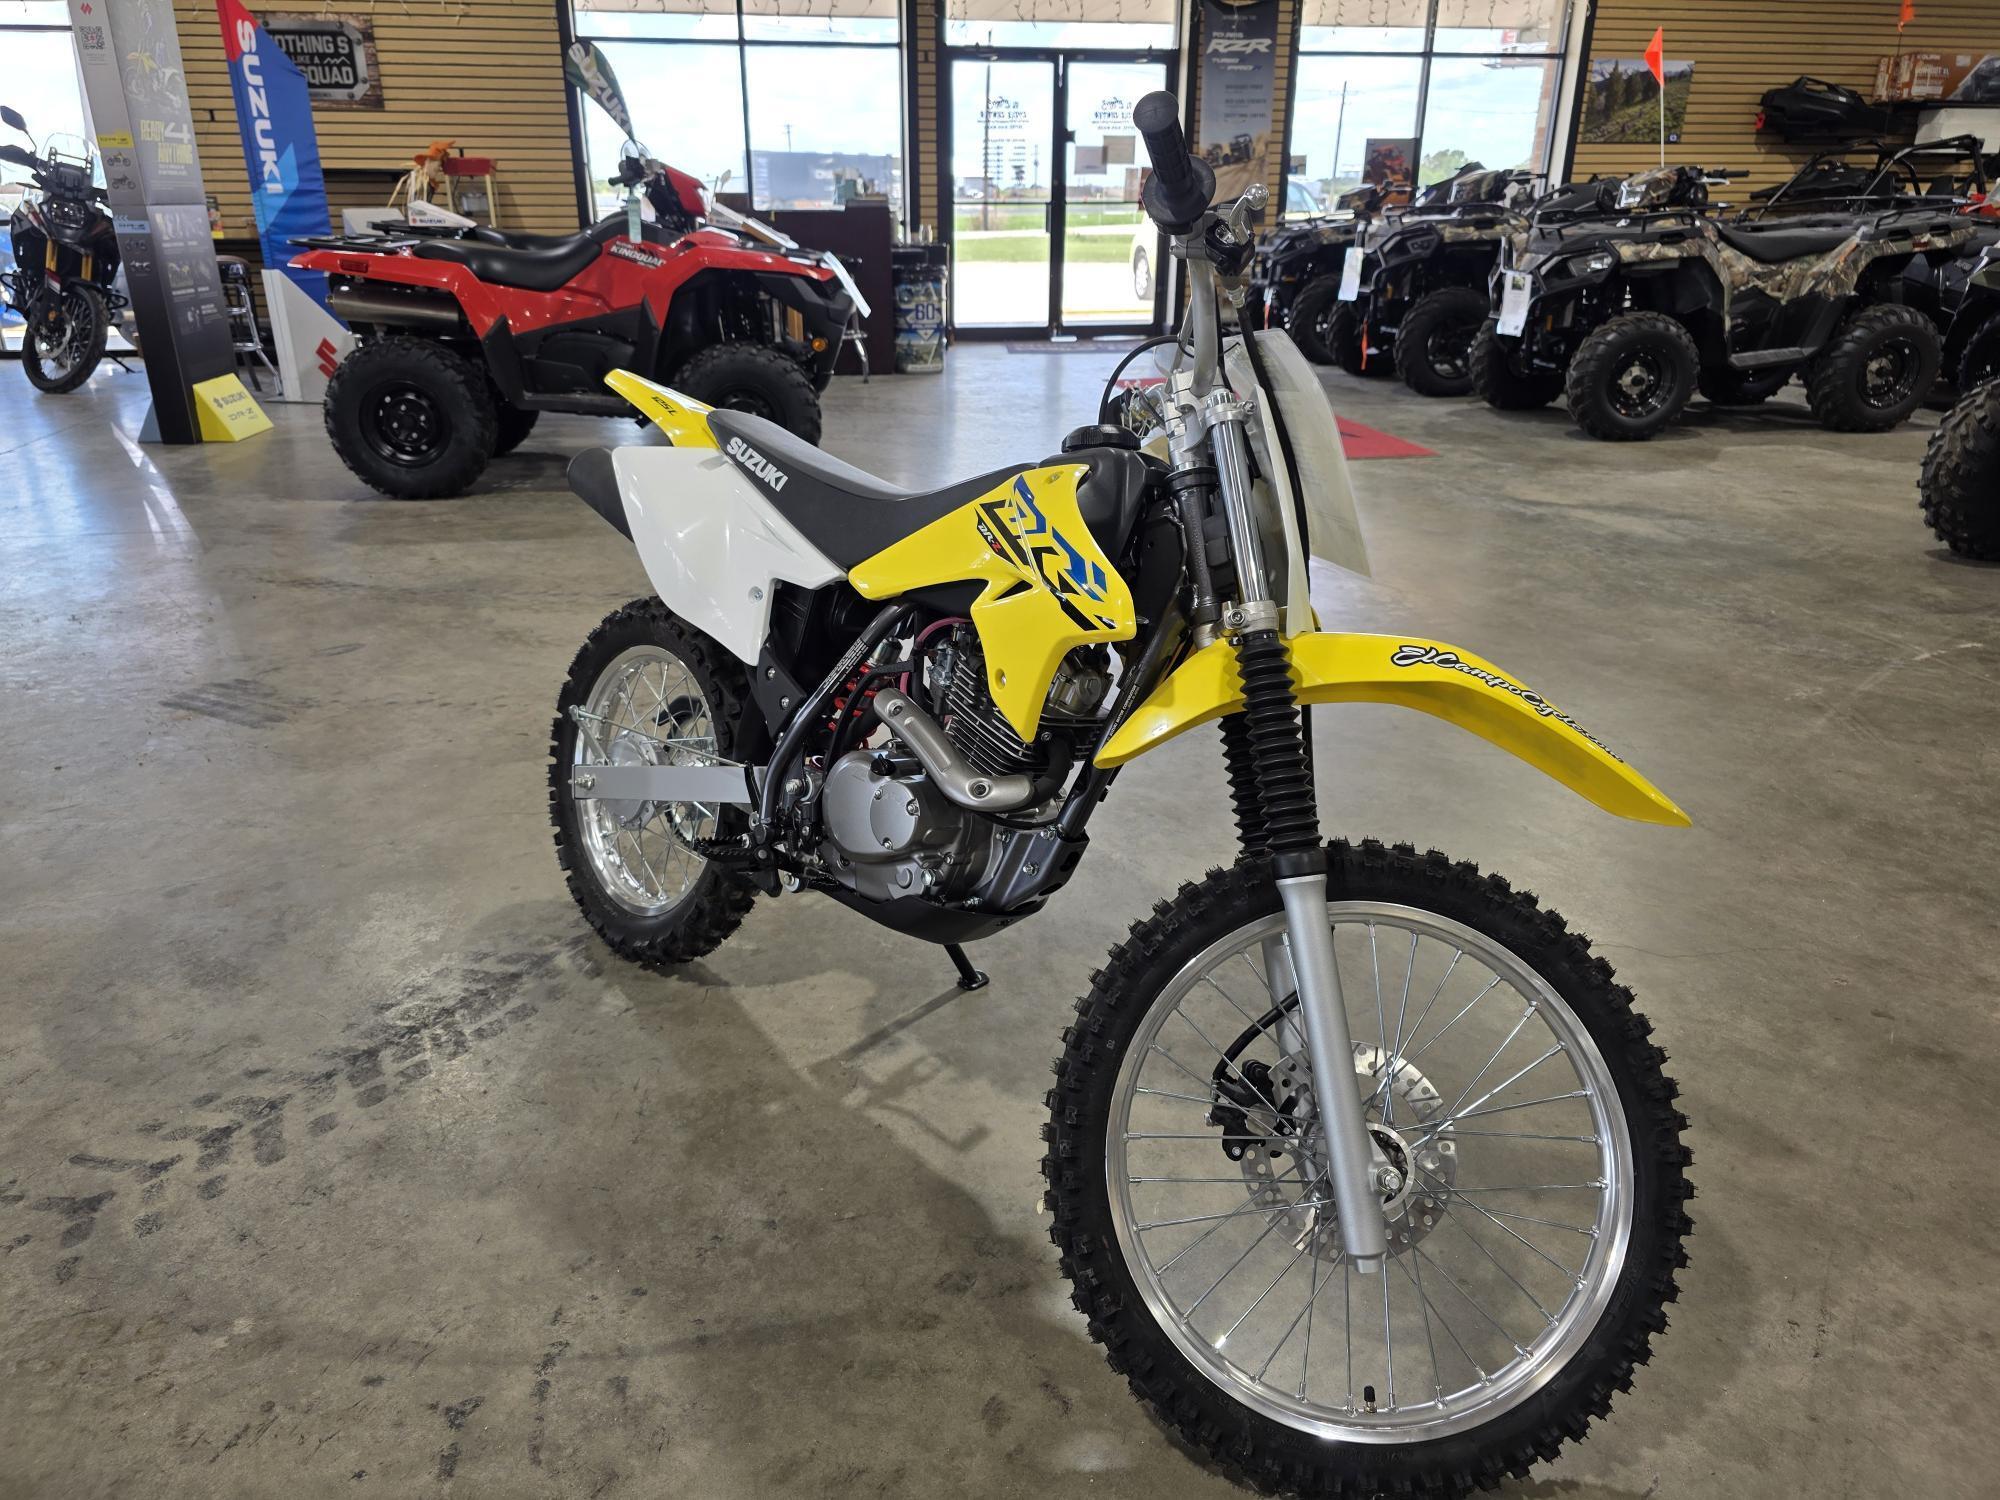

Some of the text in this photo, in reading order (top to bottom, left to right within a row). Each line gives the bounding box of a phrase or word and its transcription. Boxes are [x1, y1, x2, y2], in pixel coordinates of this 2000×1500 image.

[1206, 38, 1272, 54] RZR
[569, 43, 632, 132] SUZUKI
[236, 19, 284, 194] SUZUKI
[164, 122, 191, 143] 4
[915, 304, 935, 320] 60
[651, 395, 678, 416] 125L
[726, 436, 789, 493] SUZUKI
[977, 522, 1003, 554] DR-Z
